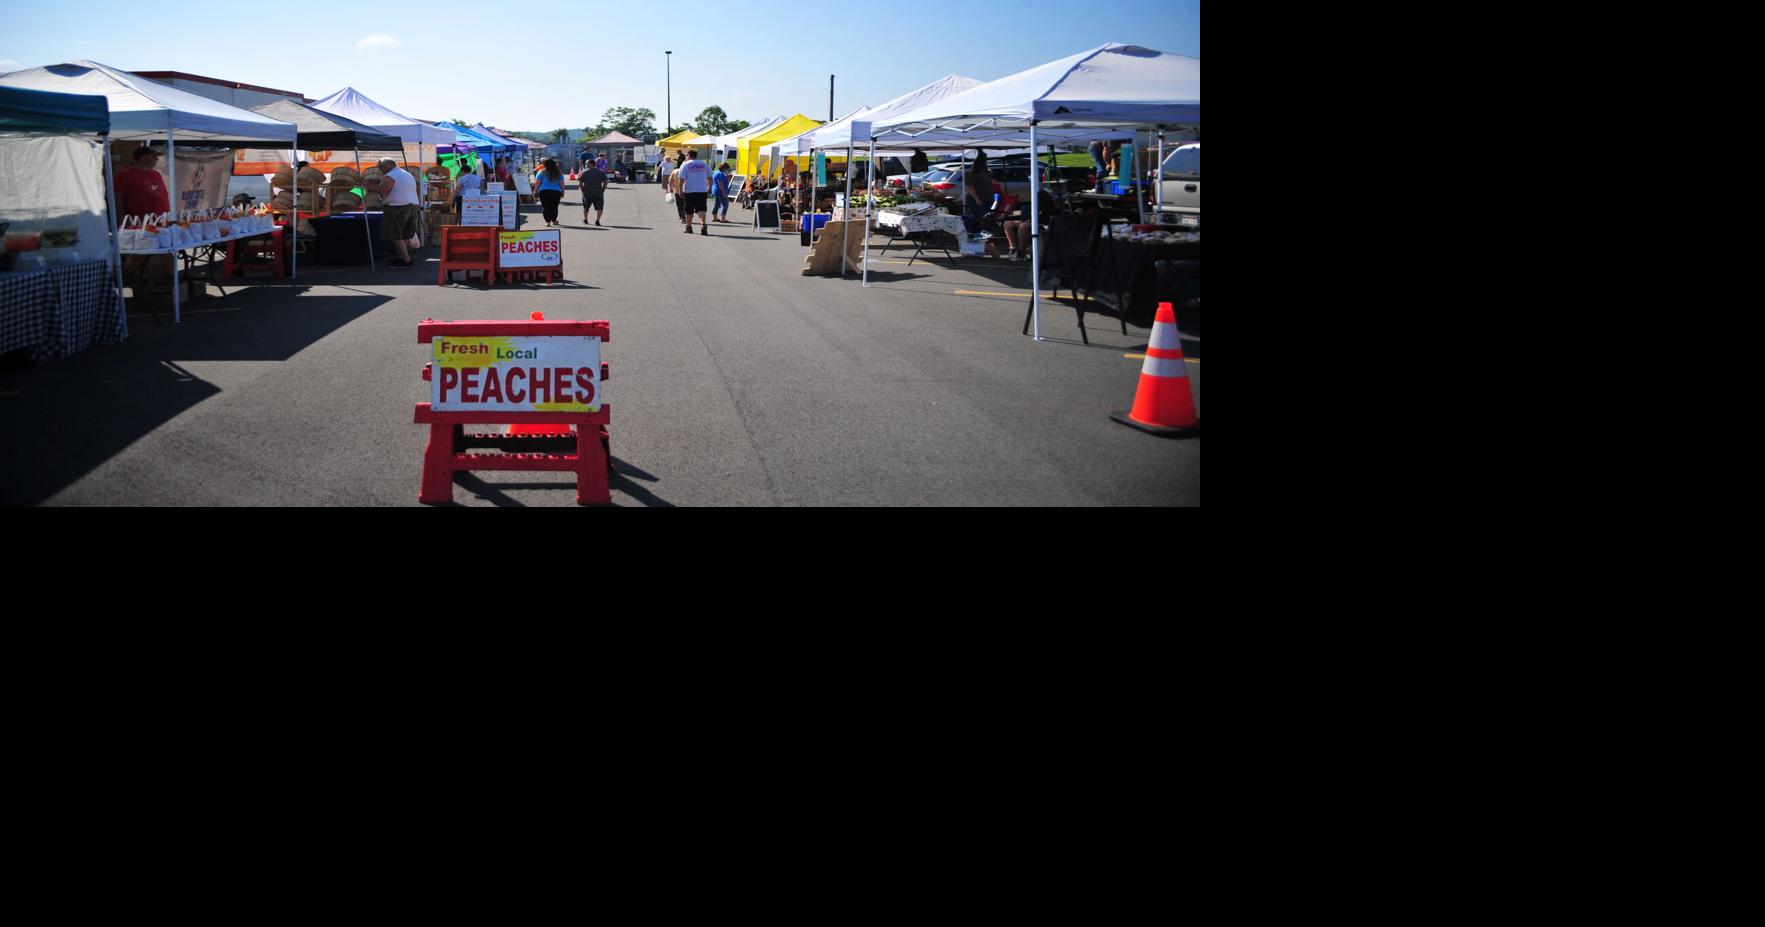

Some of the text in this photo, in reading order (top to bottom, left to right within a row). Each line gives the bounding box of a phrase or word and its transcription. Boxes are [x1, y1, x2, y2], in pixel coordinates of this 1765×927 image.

[501, 240, 558, 254] PEACHES
[441, 341, 537, 359] Fresh Local
[439, 366, 595, 404] PEACHES
